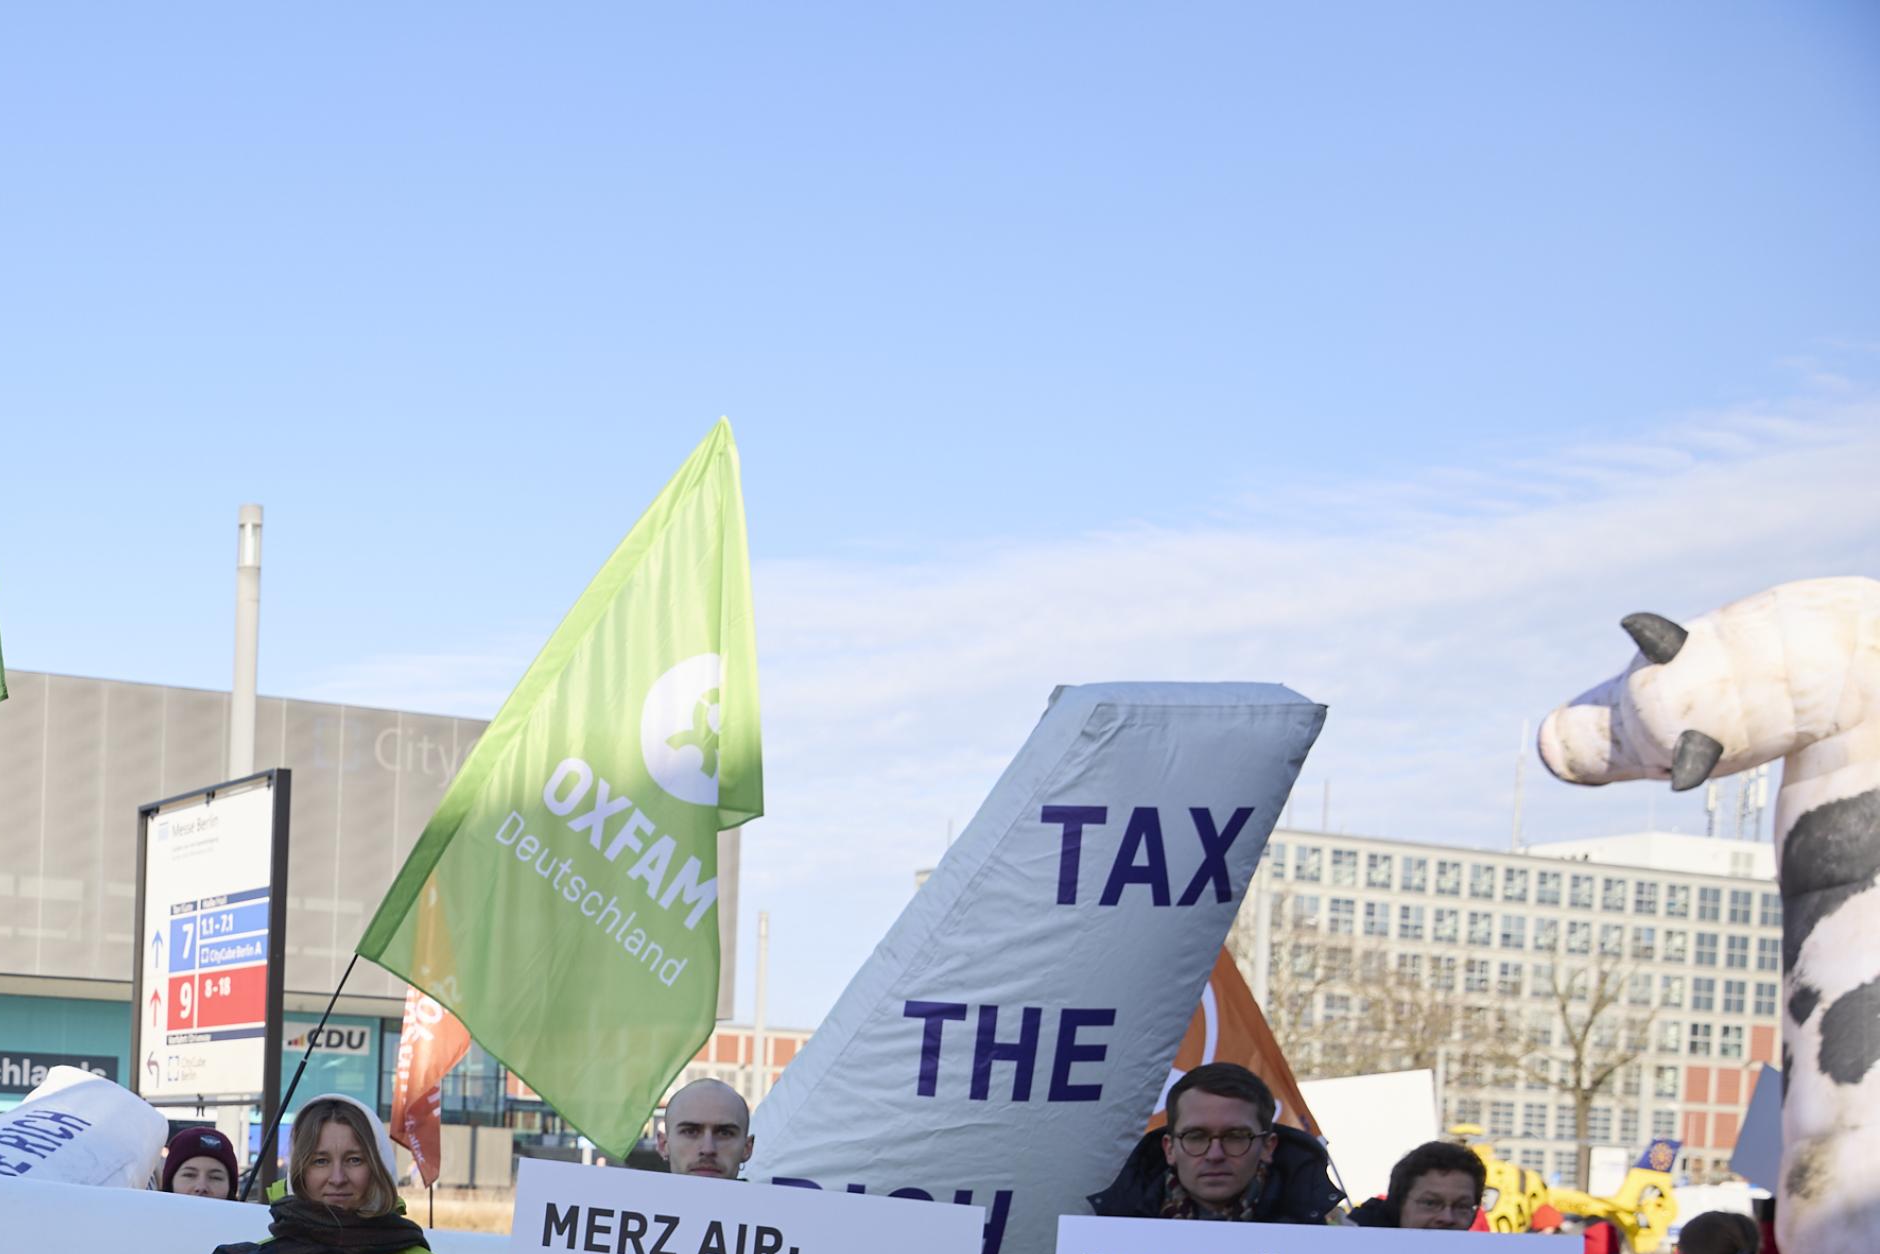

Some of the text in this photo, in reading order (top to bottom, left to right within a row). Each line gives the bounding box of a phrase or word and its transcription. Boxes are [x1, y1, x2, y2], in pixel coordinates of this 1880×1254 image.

[543, 757, 718, 931] OXFAM
[1041, 804, 1255, 907] TAX
[182, 923, 195, 960] 7
[495, 810, 688, 987] Deutschland
[180, 982, 193, 1019] 9
[307, 1028, 366, 1050] CDU
[904, 1001, 1116, 1103] THE
